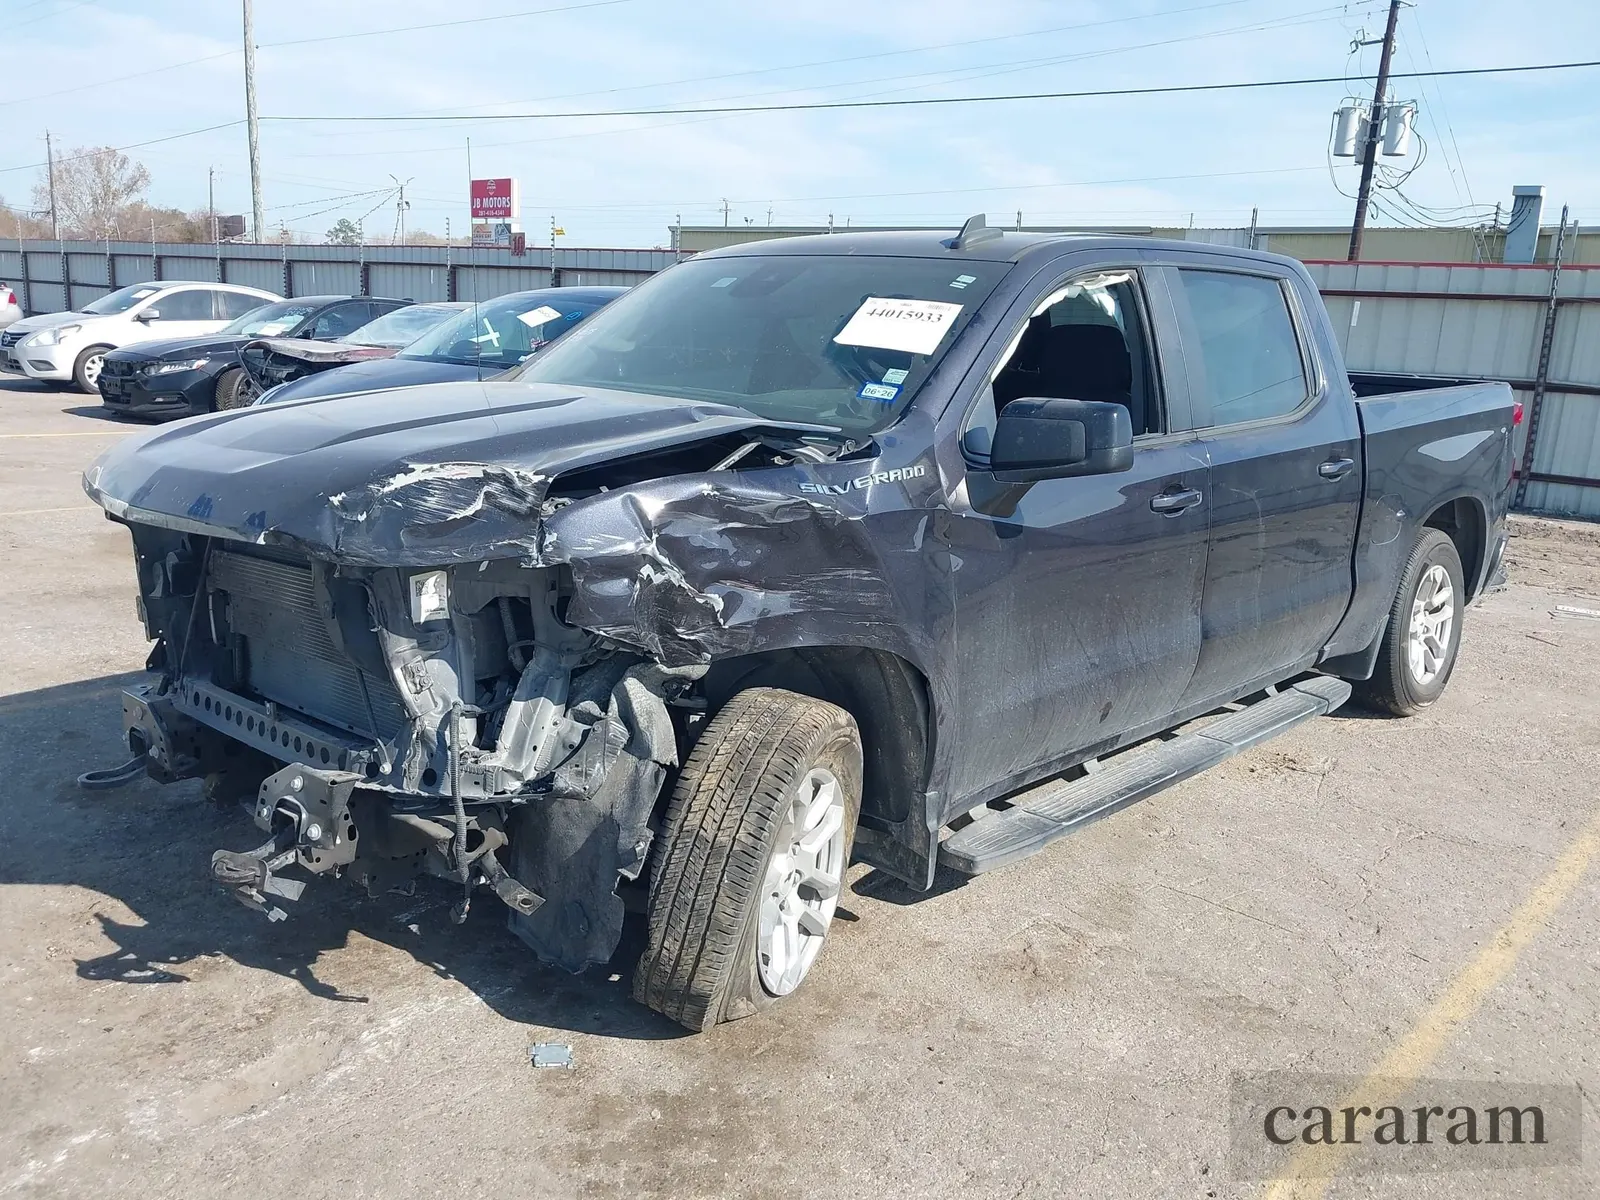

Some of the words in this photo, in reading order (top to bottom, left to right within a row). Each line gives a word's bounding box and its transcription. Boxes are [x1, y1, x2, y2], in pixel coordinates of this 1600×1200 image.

[473, 198, 481, 208] JB
[483, 197, 511, 208] MOTORS
[866, 308, 943, 323] 44015933
[799, 465, 925, 496] SILVERADO
